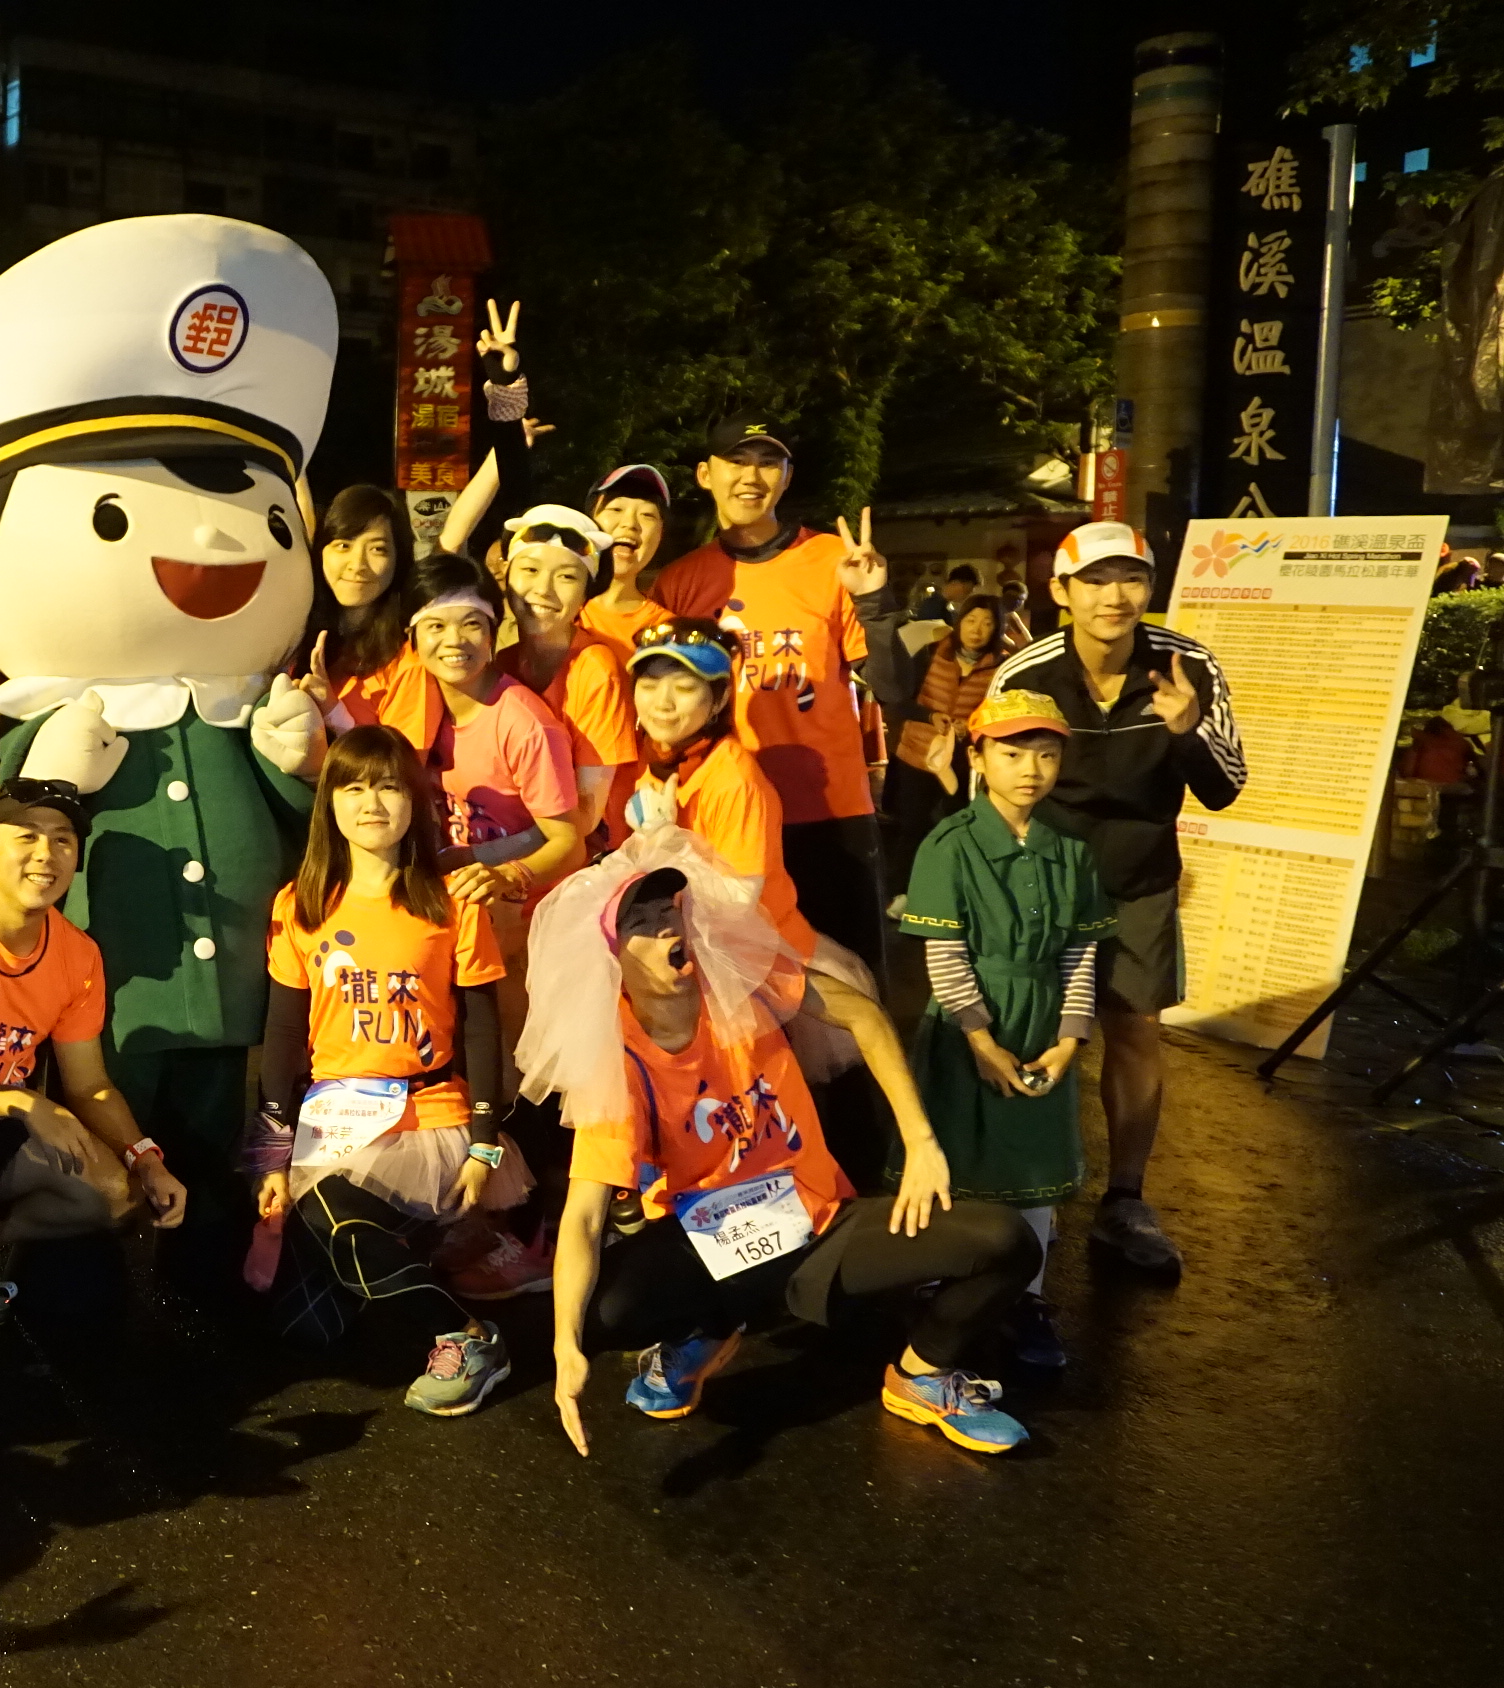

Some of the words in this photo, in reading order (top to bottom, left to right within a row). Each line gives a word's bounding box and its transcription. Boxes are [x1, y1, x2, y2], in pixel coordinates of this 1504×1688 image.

[182, 302, 239, 358] 郵
[410, 461, 457, 486] 美食
[1289, 535, 1330, 550] 2016
[1333, 534, 1426, 551] 礁溪溫泉盃
[1328, 552, 1341, 560] Hot
[1342, 552, 1366, 561] Spring
[1366, 552, 1402, 560] Marathon
[737, 662, 807, 693] RUN
[339, 967, 421, 1004] 攏來
[351, 1007, 424, 1044] RUN
[713, 1220, 761, 1248] 楊孟杰
[734, 1230, 784, 1265] 1587
